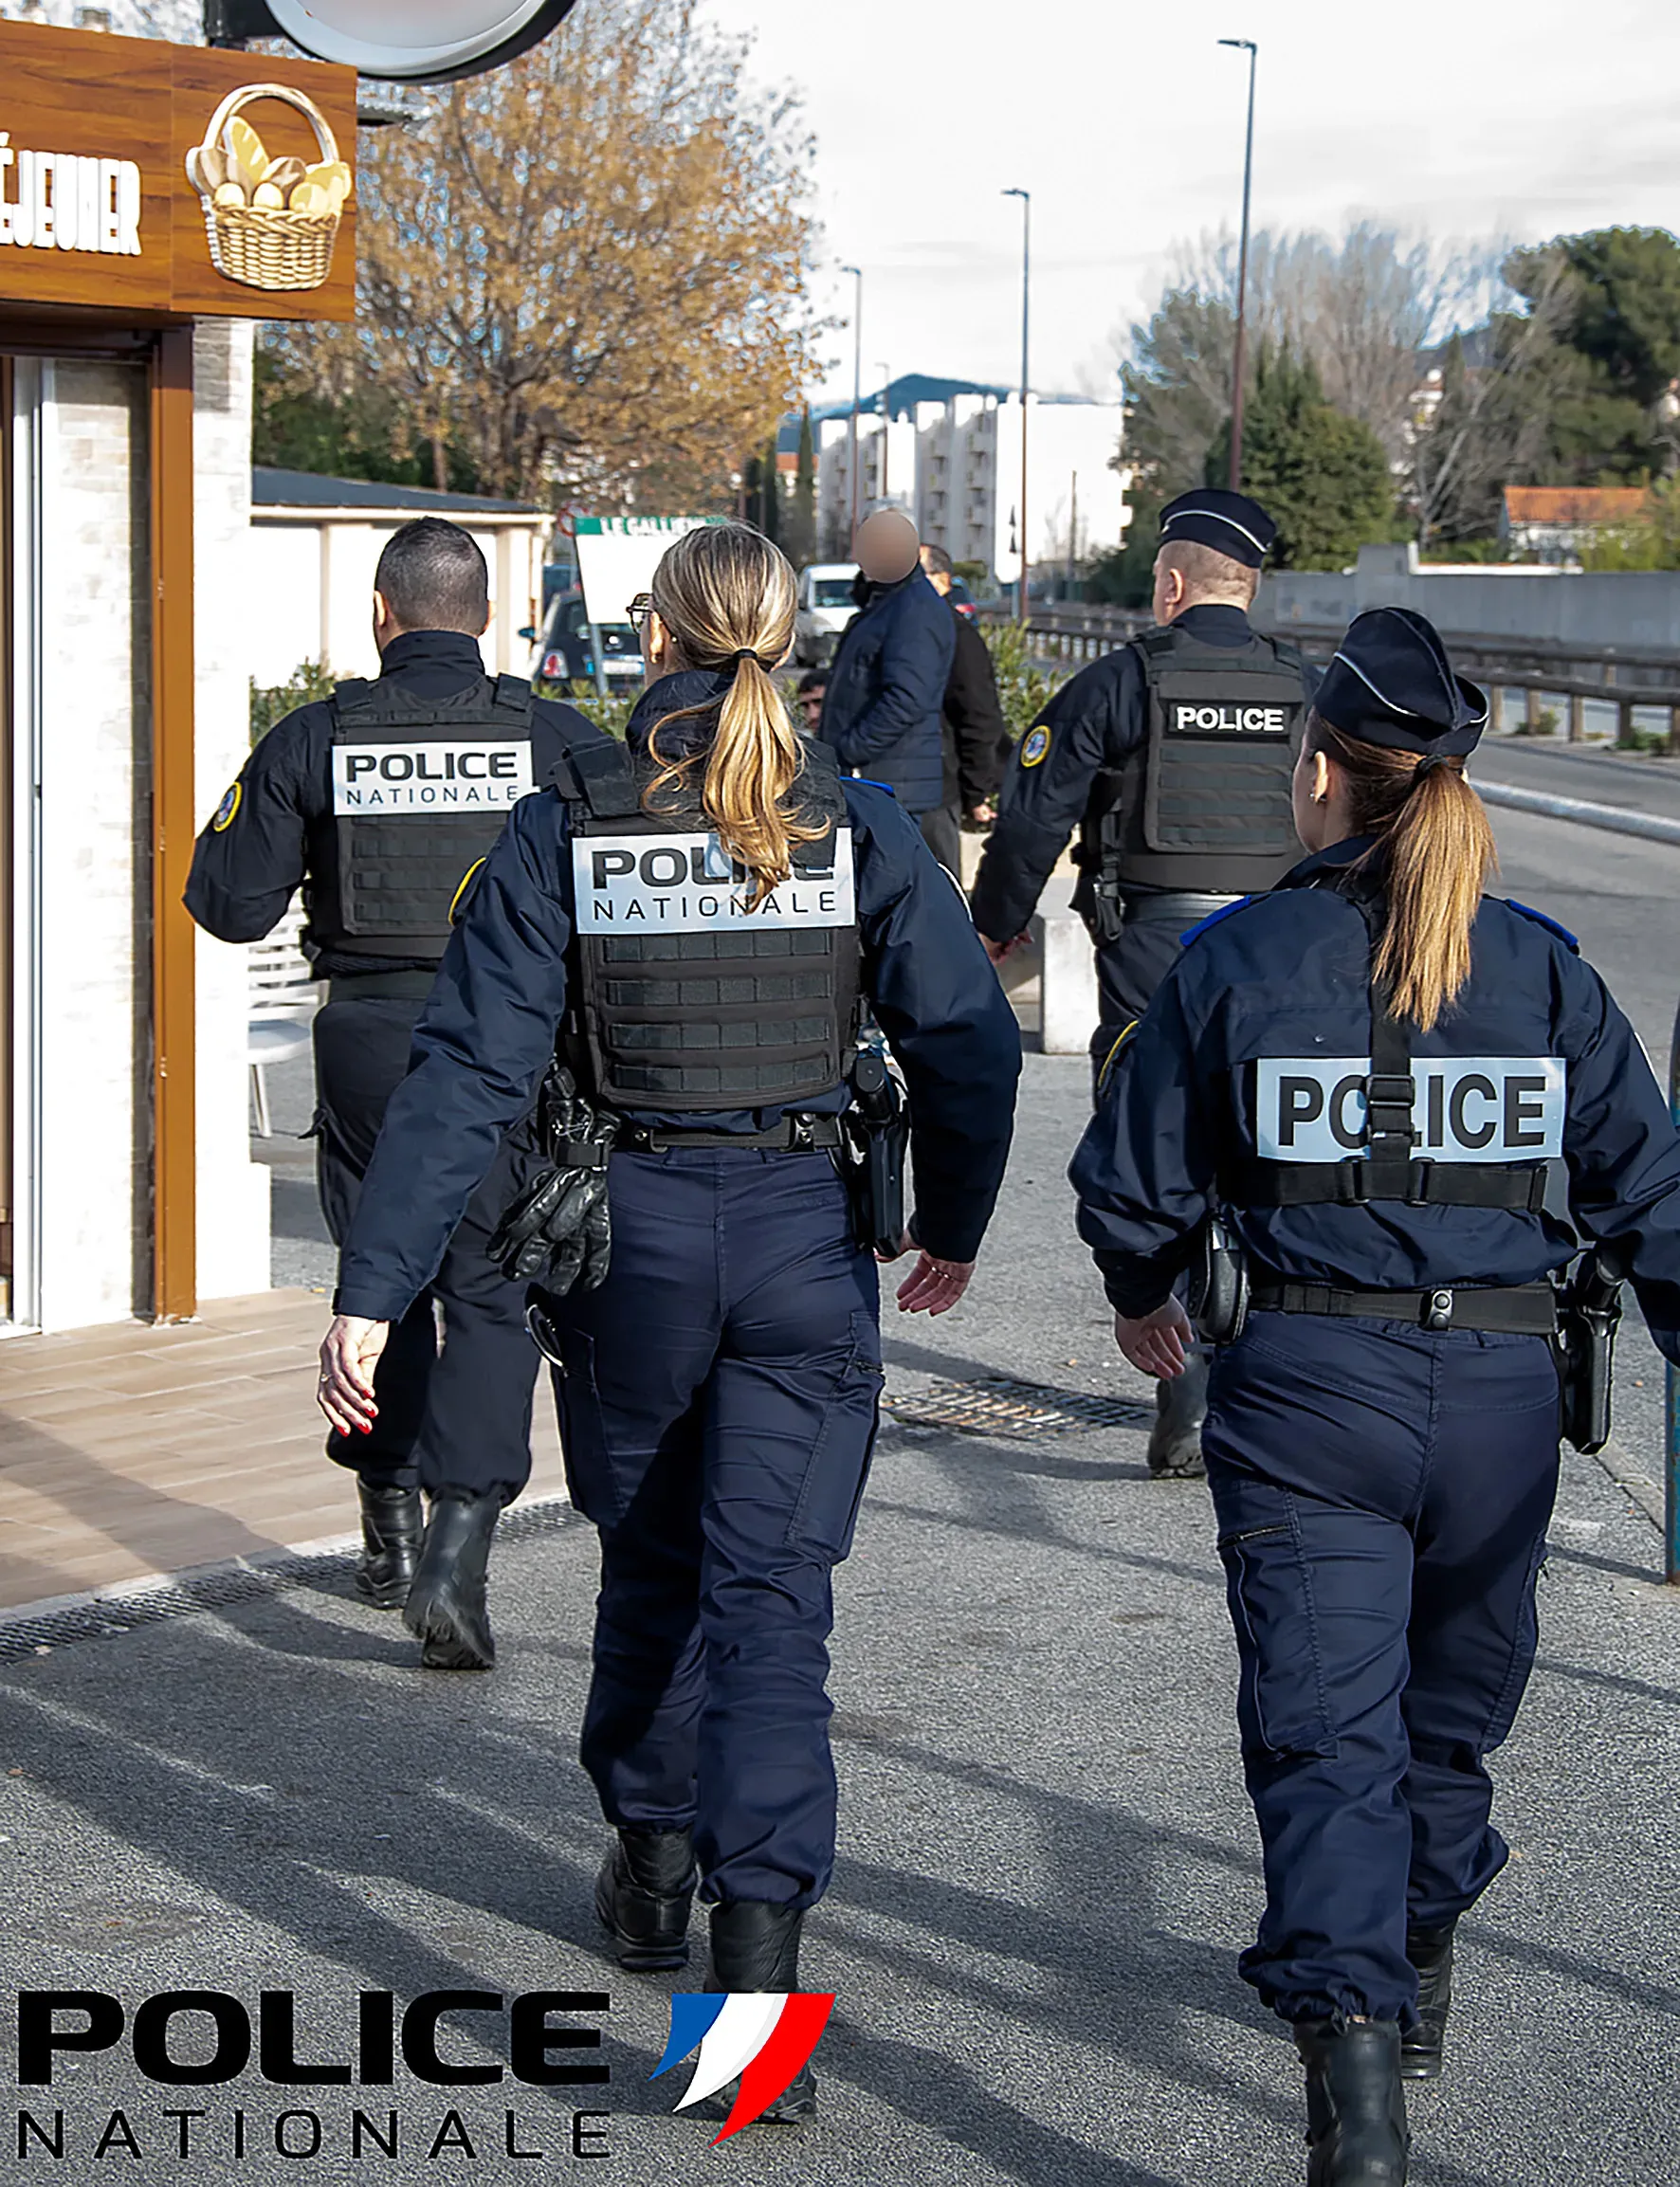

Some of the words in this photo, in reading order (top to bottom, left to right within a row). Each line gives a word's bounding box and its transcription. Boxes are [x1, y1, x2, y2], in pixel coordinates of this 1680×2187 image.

[600, 517, 626, 537] LE
[1177, 706, 1284, 731] POLICE
[346, 752, 518, 782] POLICE
[346, 786, 519, 805] NATIONALE
[593, 891, 836, 920] NATIONALE
[1278, 1073, 1546, 1149] POICE
